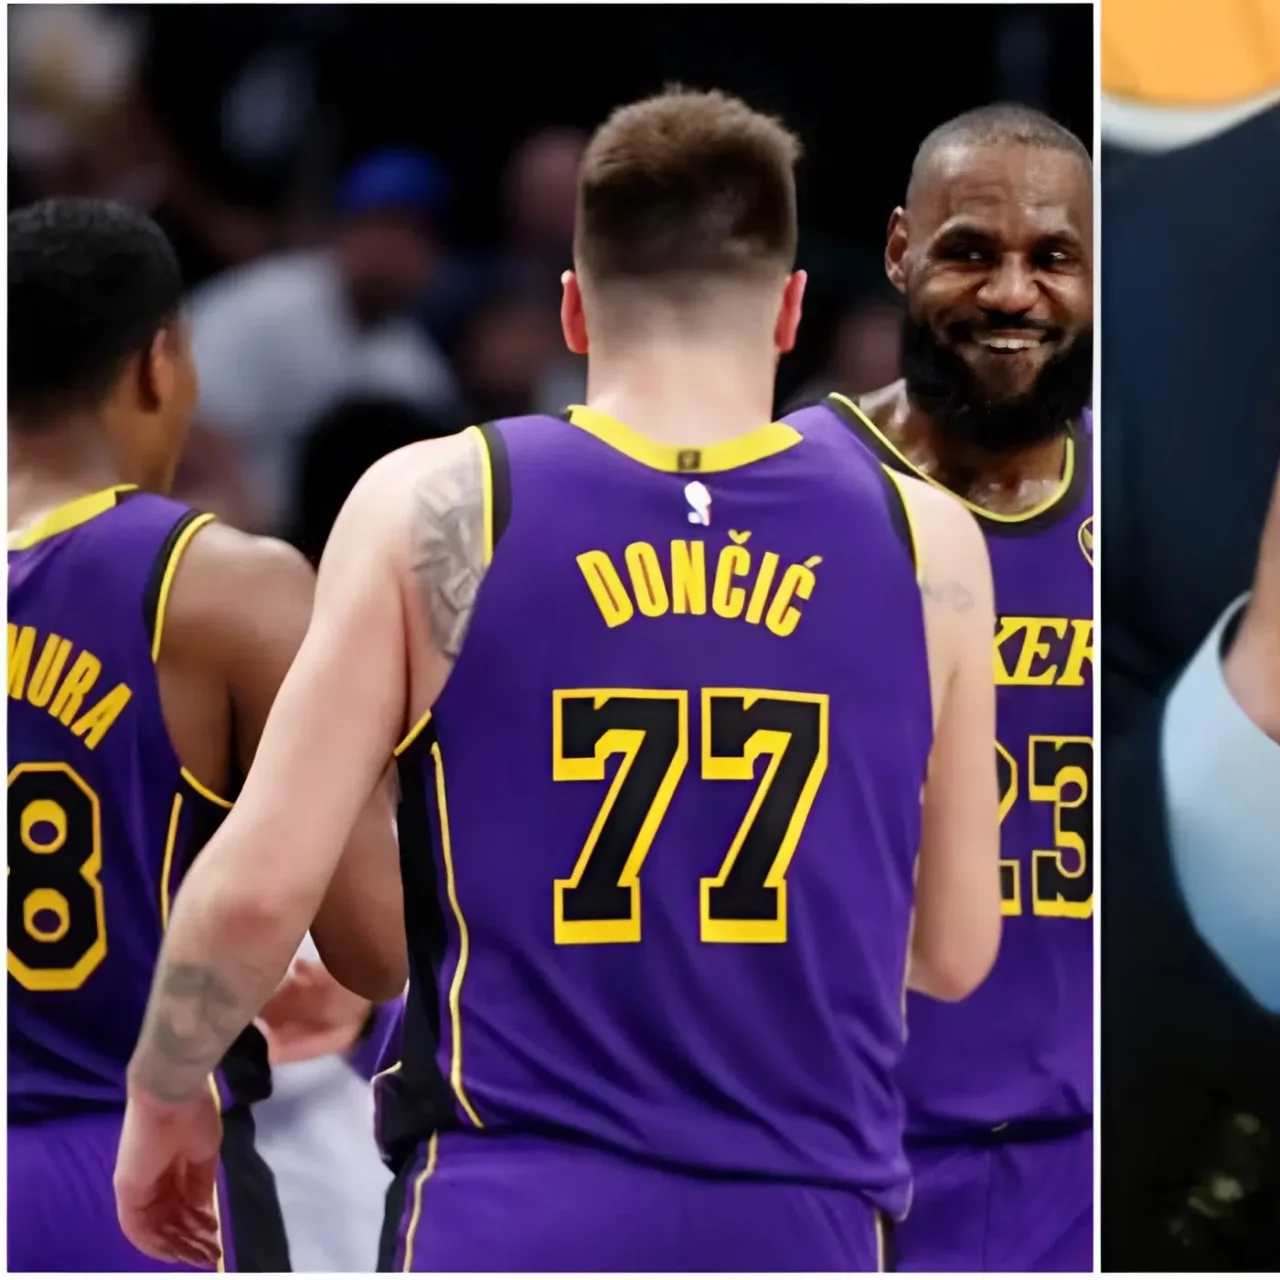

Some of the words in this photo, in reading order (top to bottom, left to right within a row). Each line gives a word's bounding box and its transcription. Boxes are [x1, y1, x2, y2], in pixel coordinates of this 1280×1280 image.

[576, 529, 823, 638] DONČIĆ
[7, 761, 107, 991] 8
[553, 687, 829, 945] 77
